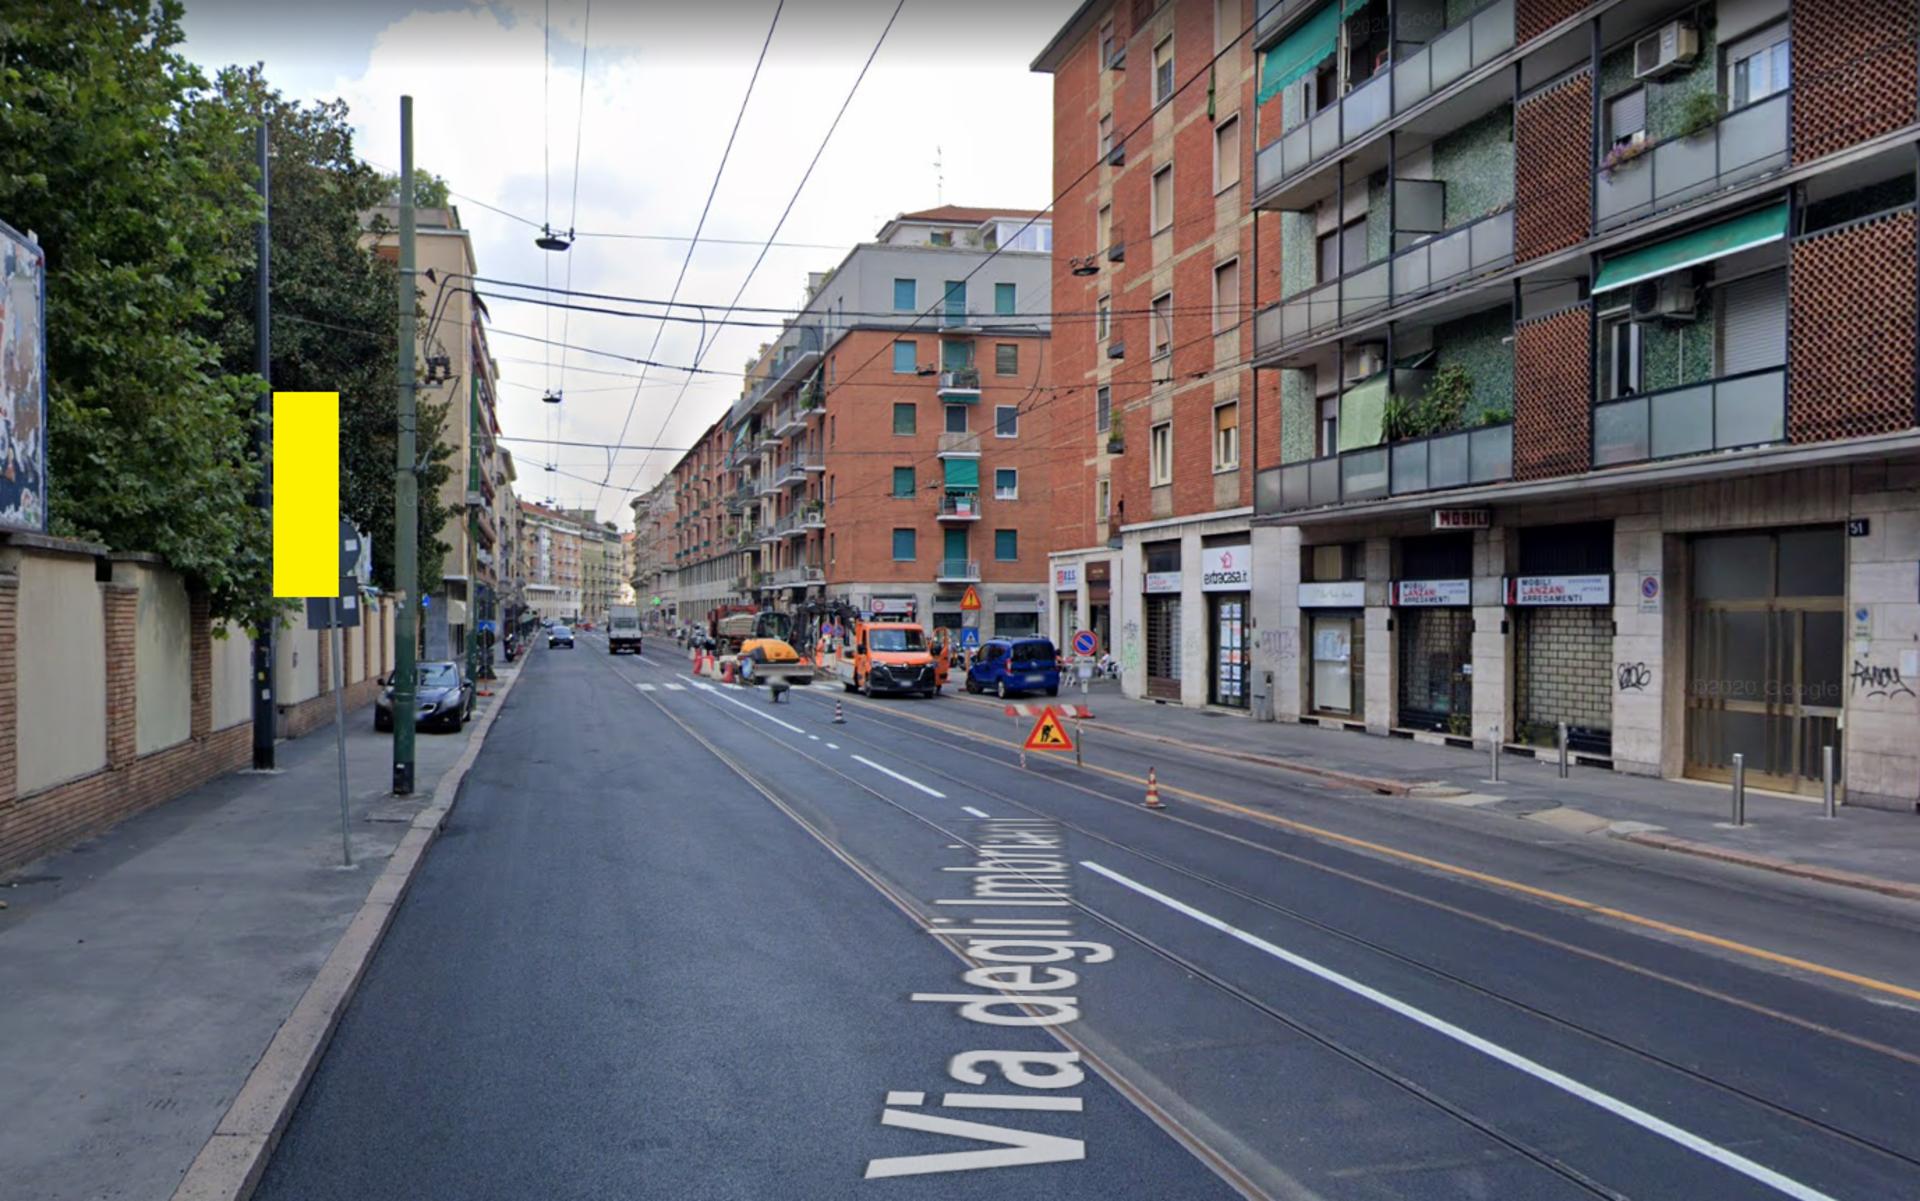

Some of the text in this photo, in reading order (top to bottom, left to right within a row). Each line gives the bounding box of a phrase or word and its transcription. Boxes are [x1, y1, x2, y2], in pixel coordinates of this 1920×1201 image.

[1440, 511, 1488, 526] MOBILI
[1521, 578, 1552, 586] MOBILI
[1521, 585, 1566, 595] LANZANI
[1521, 594, 1583, 602] ARREDAMENTI
